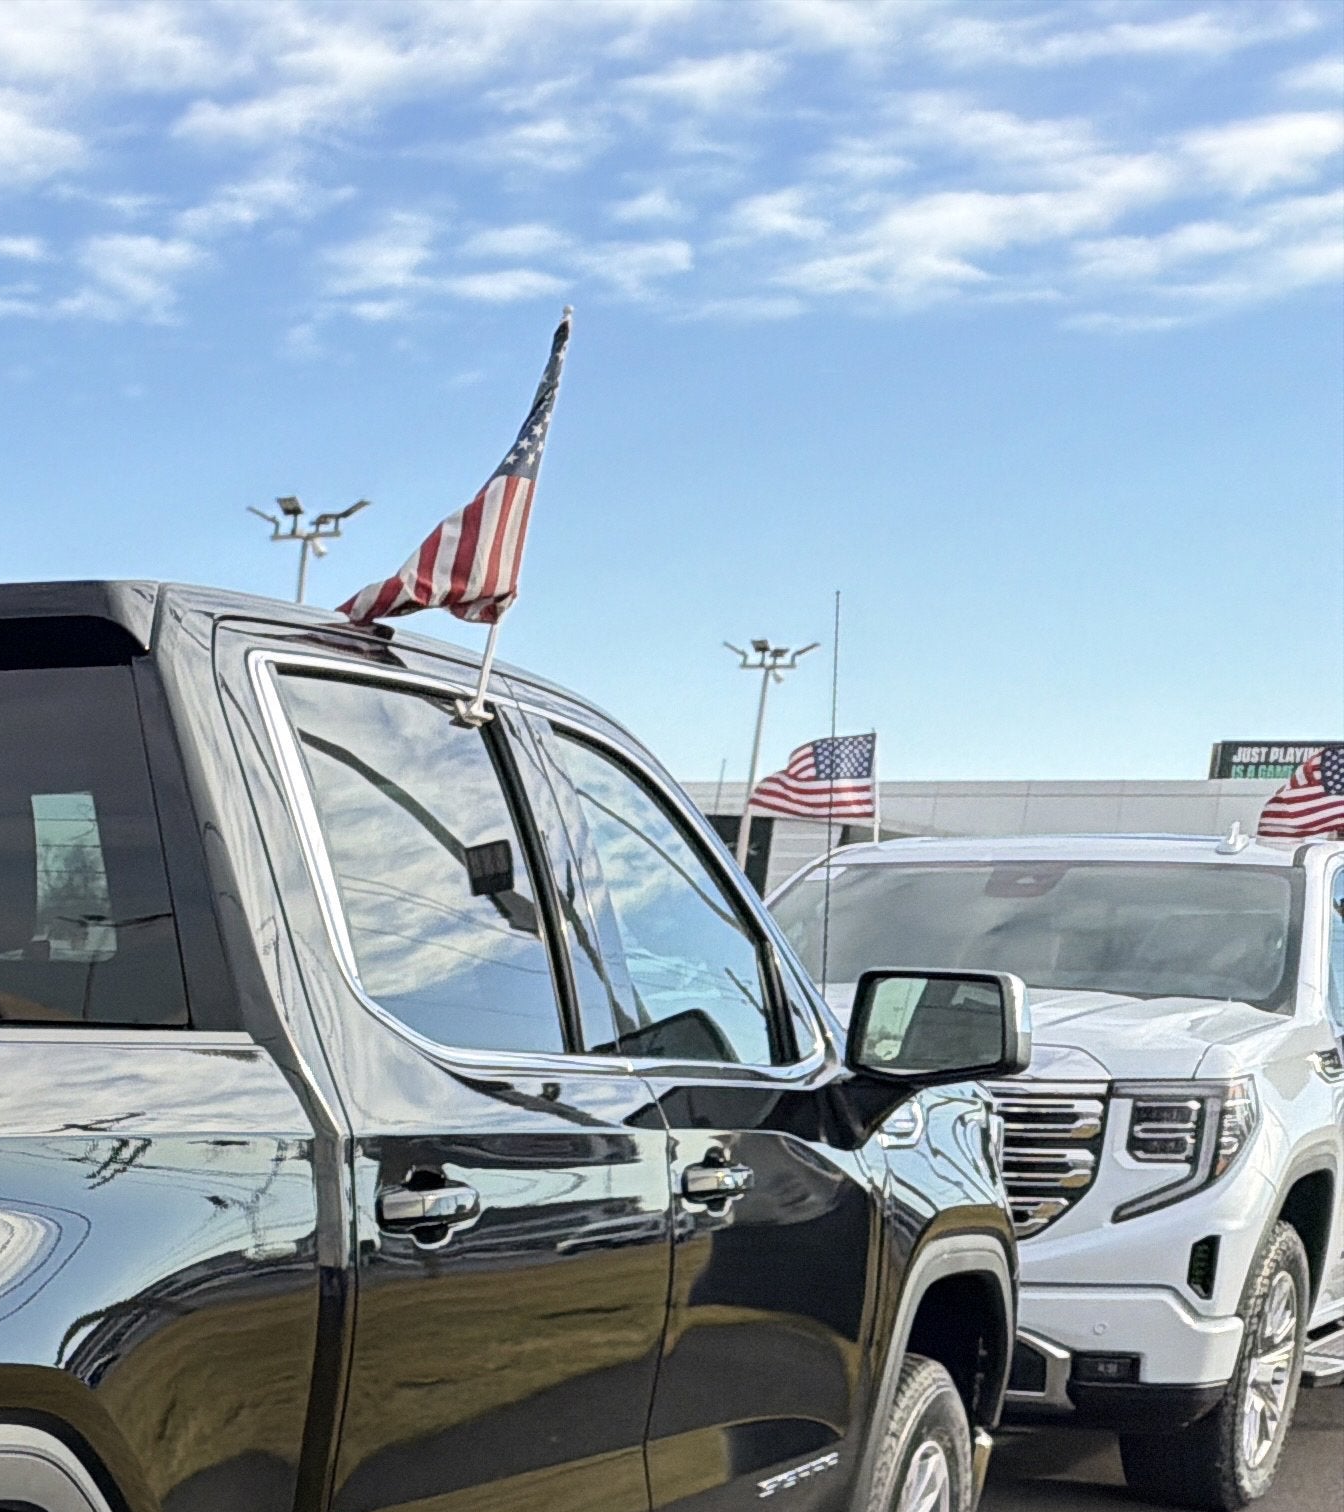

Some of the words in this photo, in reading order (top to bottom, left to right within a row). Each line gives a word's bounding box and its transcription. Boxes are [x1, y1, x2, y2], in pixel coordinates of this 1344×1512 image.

[1232, 746, 1269, 763] JUST
[1232, 765, 1245, 779] IS
[1247, 765, 1256, 779] A
